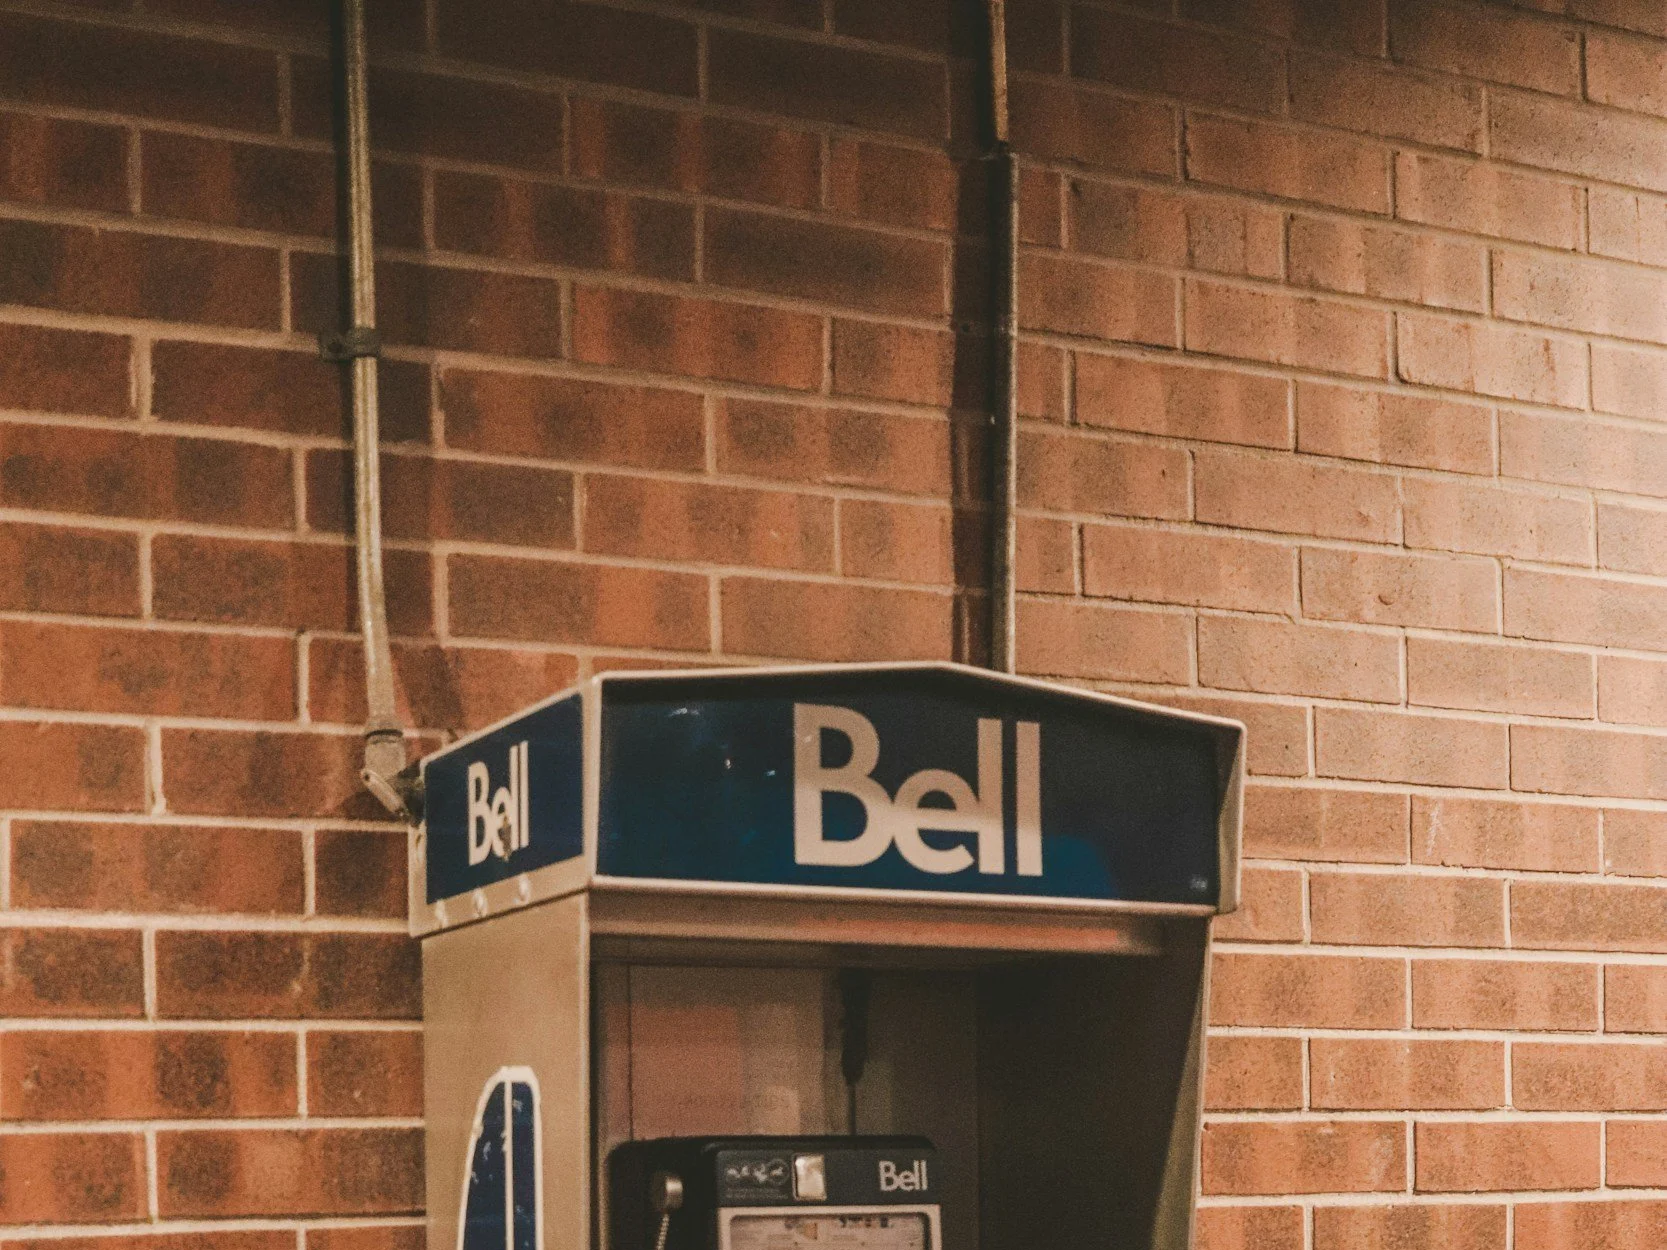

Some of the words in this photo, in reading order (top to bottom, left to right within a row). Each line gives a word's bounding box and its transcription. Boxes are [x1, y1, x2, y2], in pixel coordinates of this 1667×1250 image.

[467, 740, 529, 867] Bell
[793, 703, 1044, 877] Bell
[879, 1160, 928, 1192] Bell
